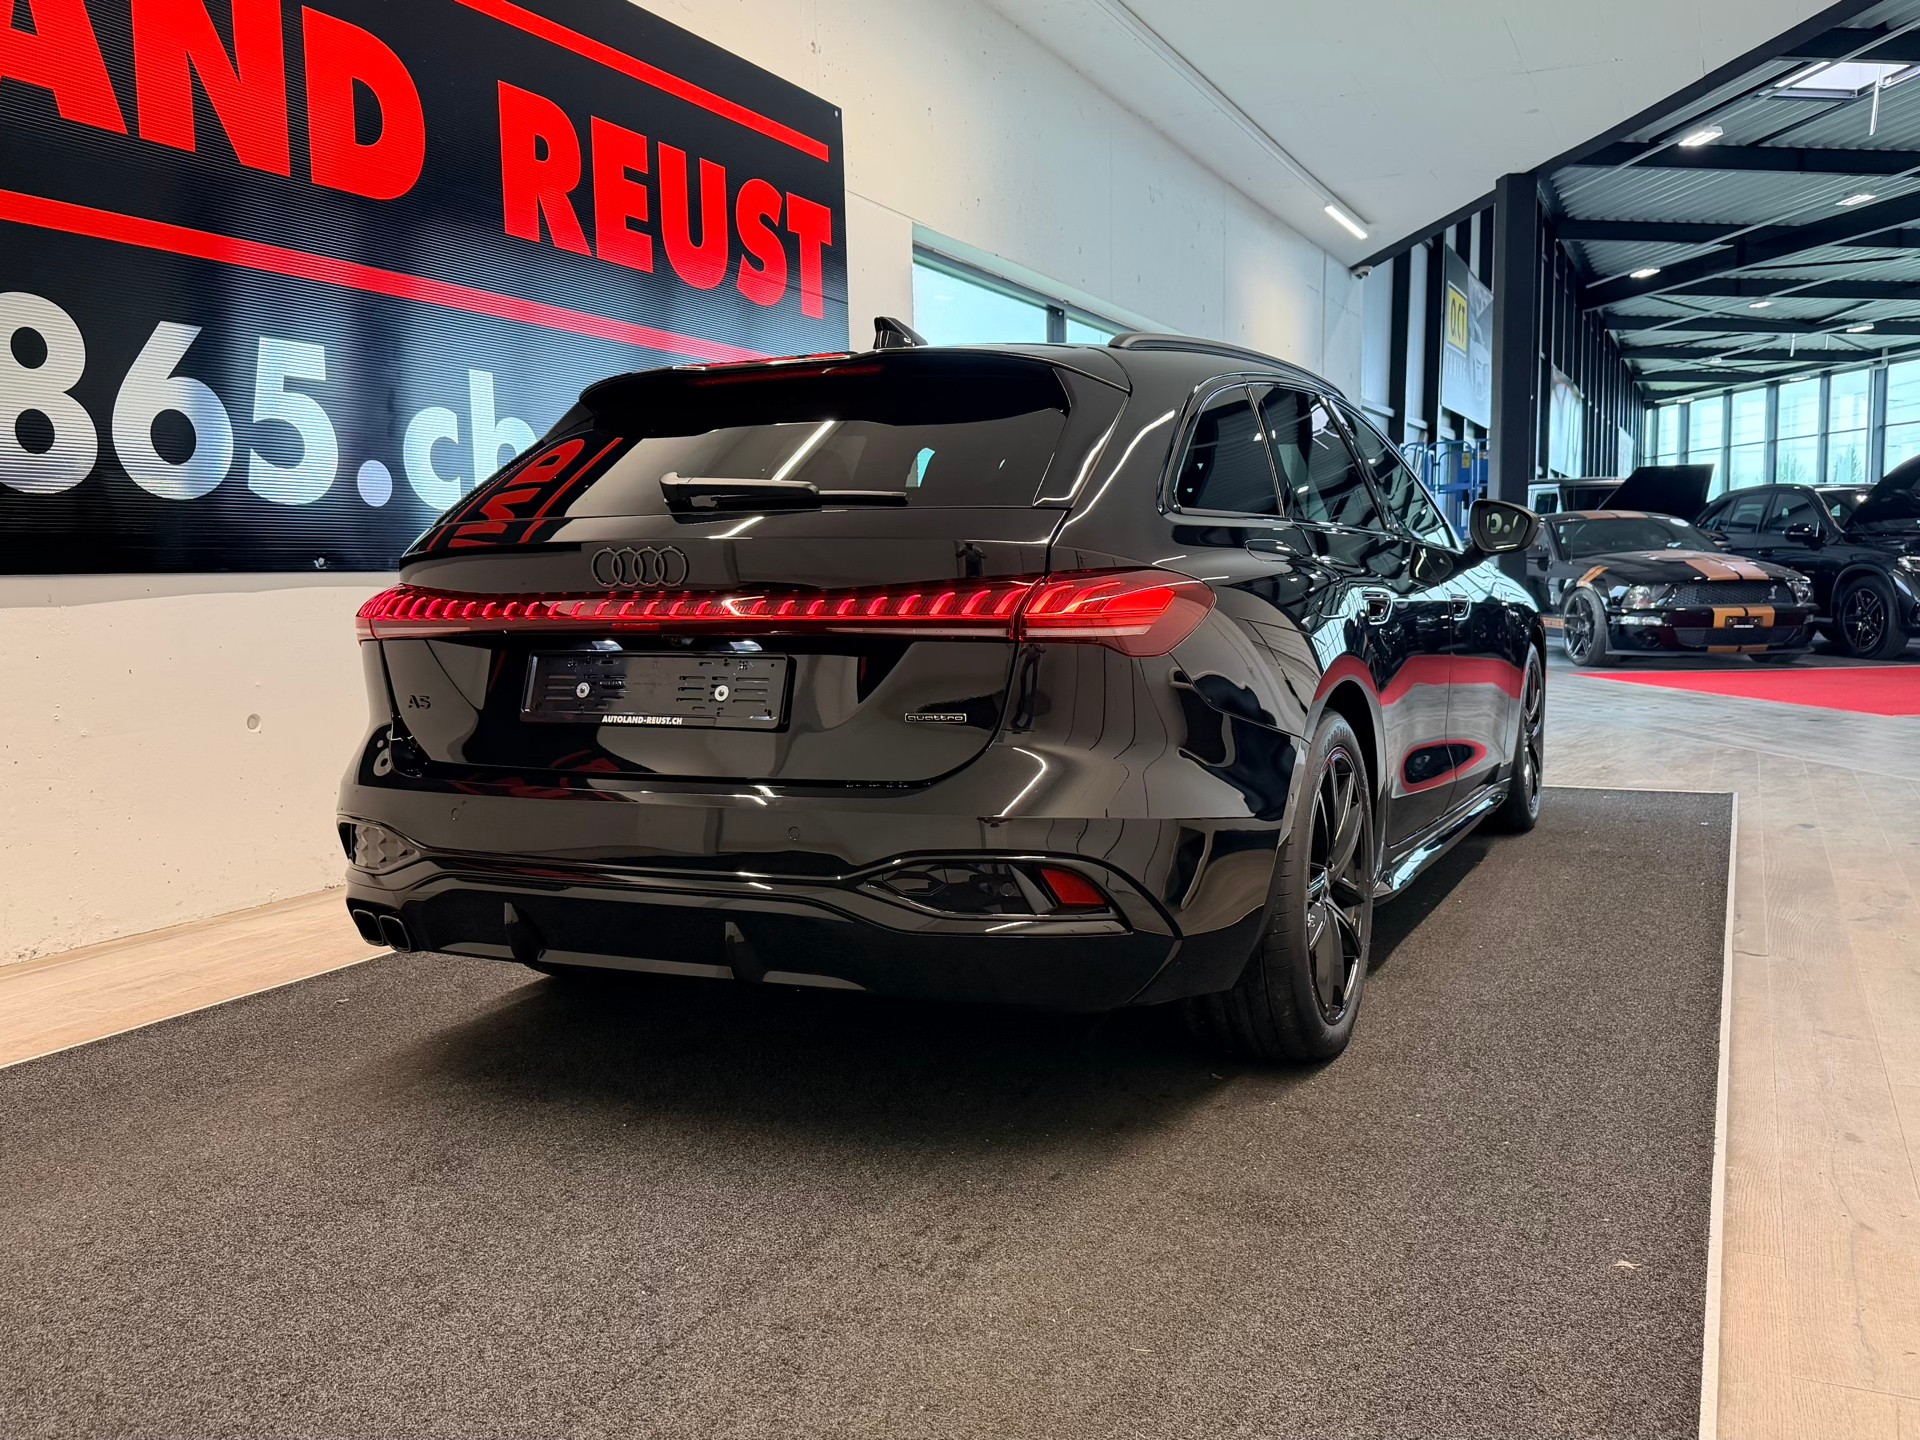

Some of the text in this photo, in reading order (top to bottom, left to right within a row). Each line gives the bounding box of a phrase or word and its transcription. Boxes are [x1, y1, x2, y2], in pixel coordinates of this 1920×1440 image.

[497, 79, 833, 319] REUST
[408, 694, 431, 710] A5
[601, 714, 684, 726] AUTOLAND-REUST.CH
[907, 714, 964, 722] quattro
